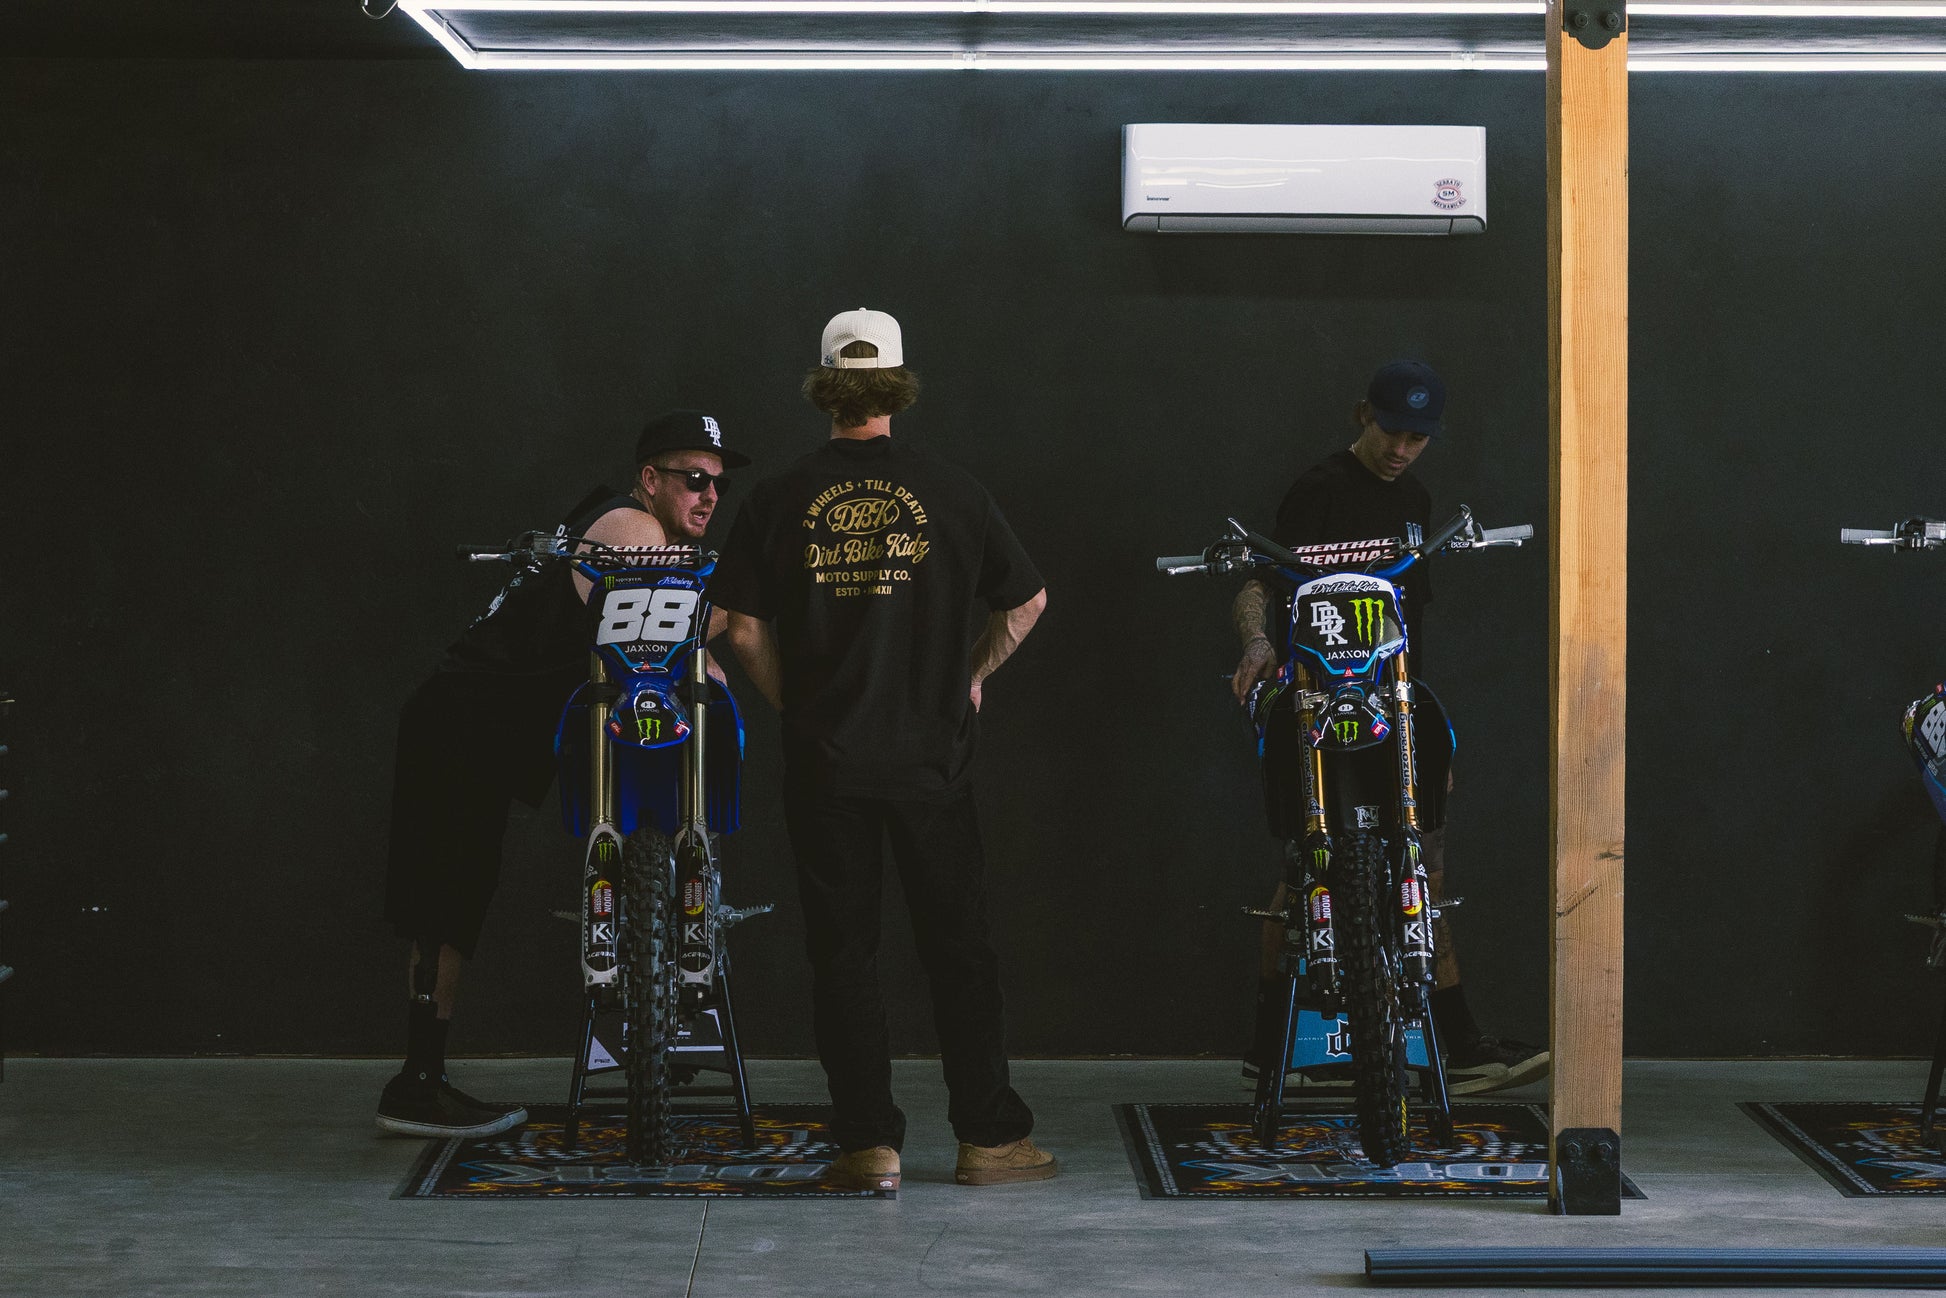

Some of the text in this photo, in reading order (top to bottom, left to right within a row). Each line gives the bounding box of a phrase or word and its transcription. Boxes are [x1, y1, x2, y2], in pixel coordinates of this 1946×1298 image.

[803, 479, 928, 530] 2 WHEELS TILL DEATH
[831, 499, 896, 532] DBK
[804, 532, 930, 569] Dirt Bike Kidz
[1292, 538, 1395, 554] RENTHAL
[1300, 549, 1394, 565] RENTHAL
[816, 570, 912, 583] MOTO SUPPLY CO.
[835, 587, 861, 597] ESTD
[596, 588, 698, 646] 88
[603, 888, 613, 913] MOON
[684, 882, 694, 907] MOON
[1321, 894, 1331, 919] MOON
[1401, 882, 1411, 907] MOON
[1423, 881, 1435, 951] DUNLOP
